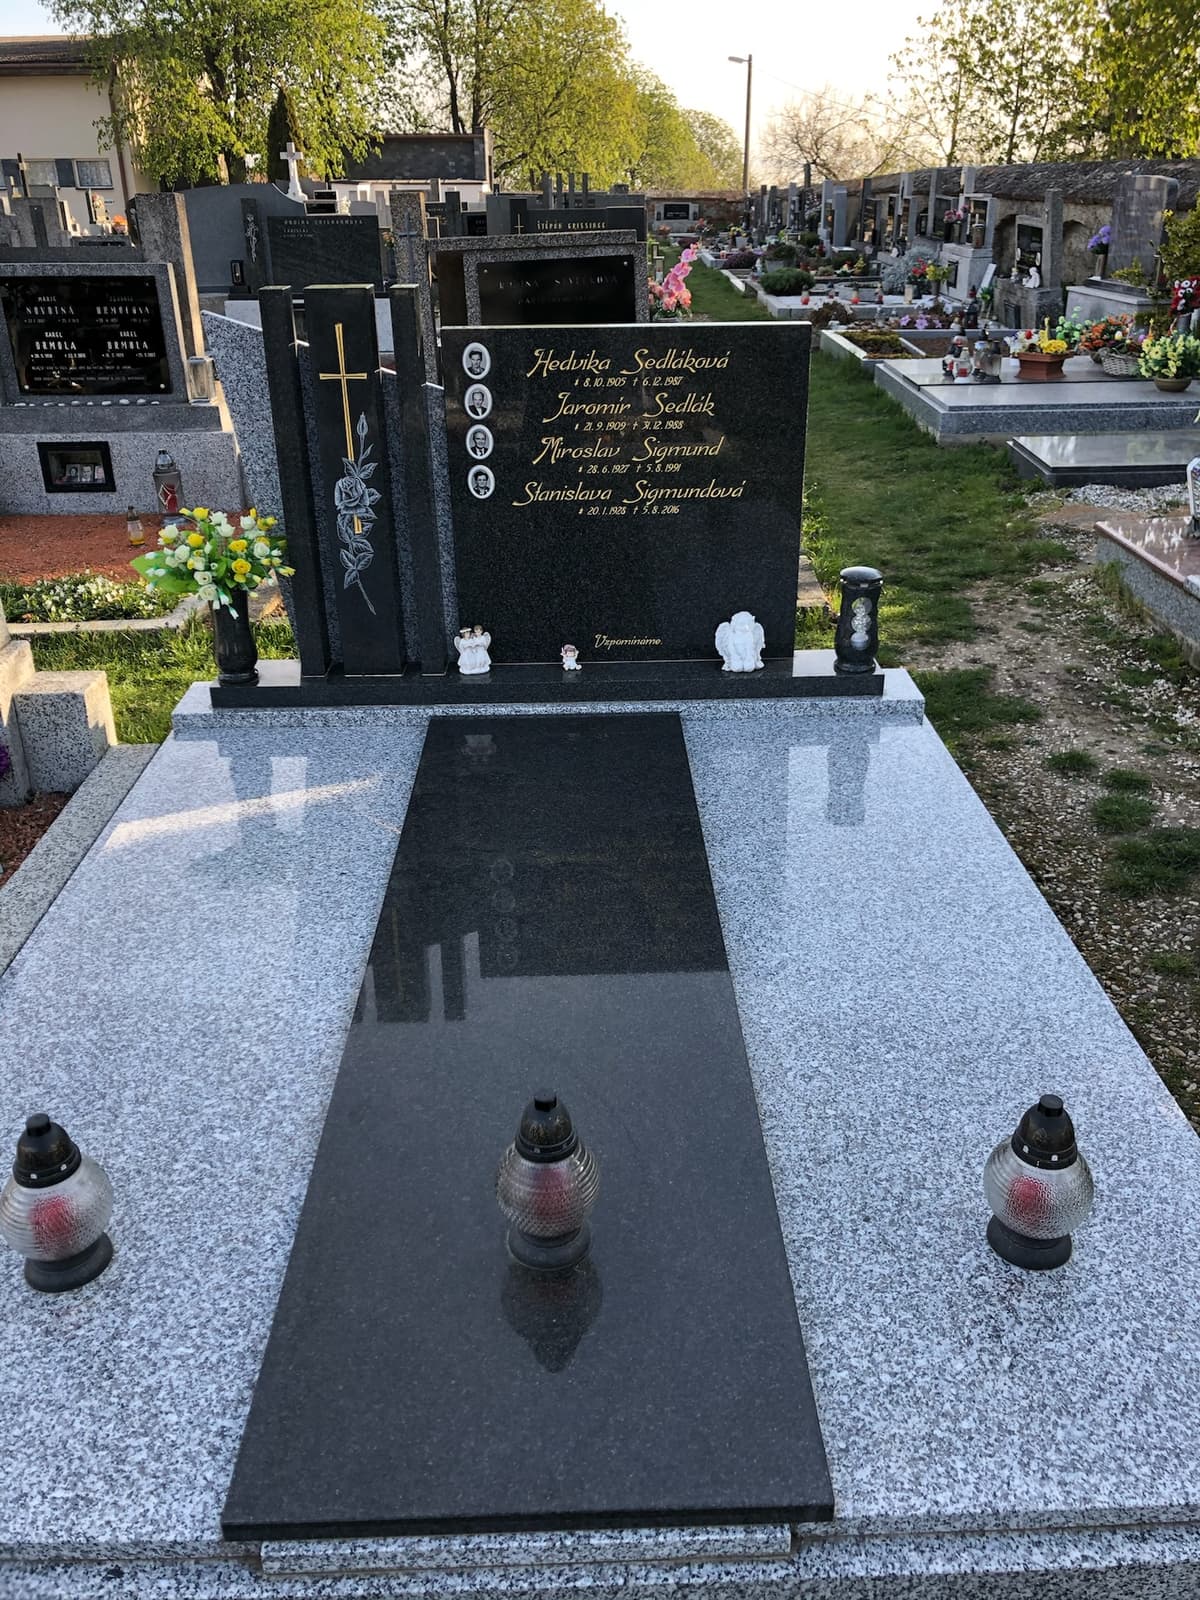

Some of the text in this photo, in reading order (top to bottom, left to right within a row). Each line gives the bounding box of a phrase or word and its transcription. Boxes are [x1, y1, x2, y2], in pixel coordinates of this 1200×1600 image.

[526, 349, 731, 378] Hedvika Sedláková
[542, 391, 715, 423] Jaromír Sedlák
[532, 435, 725, 464] Miroslav Sigmund
[511, 479, 747, 506] Stanislava Sigmundová
